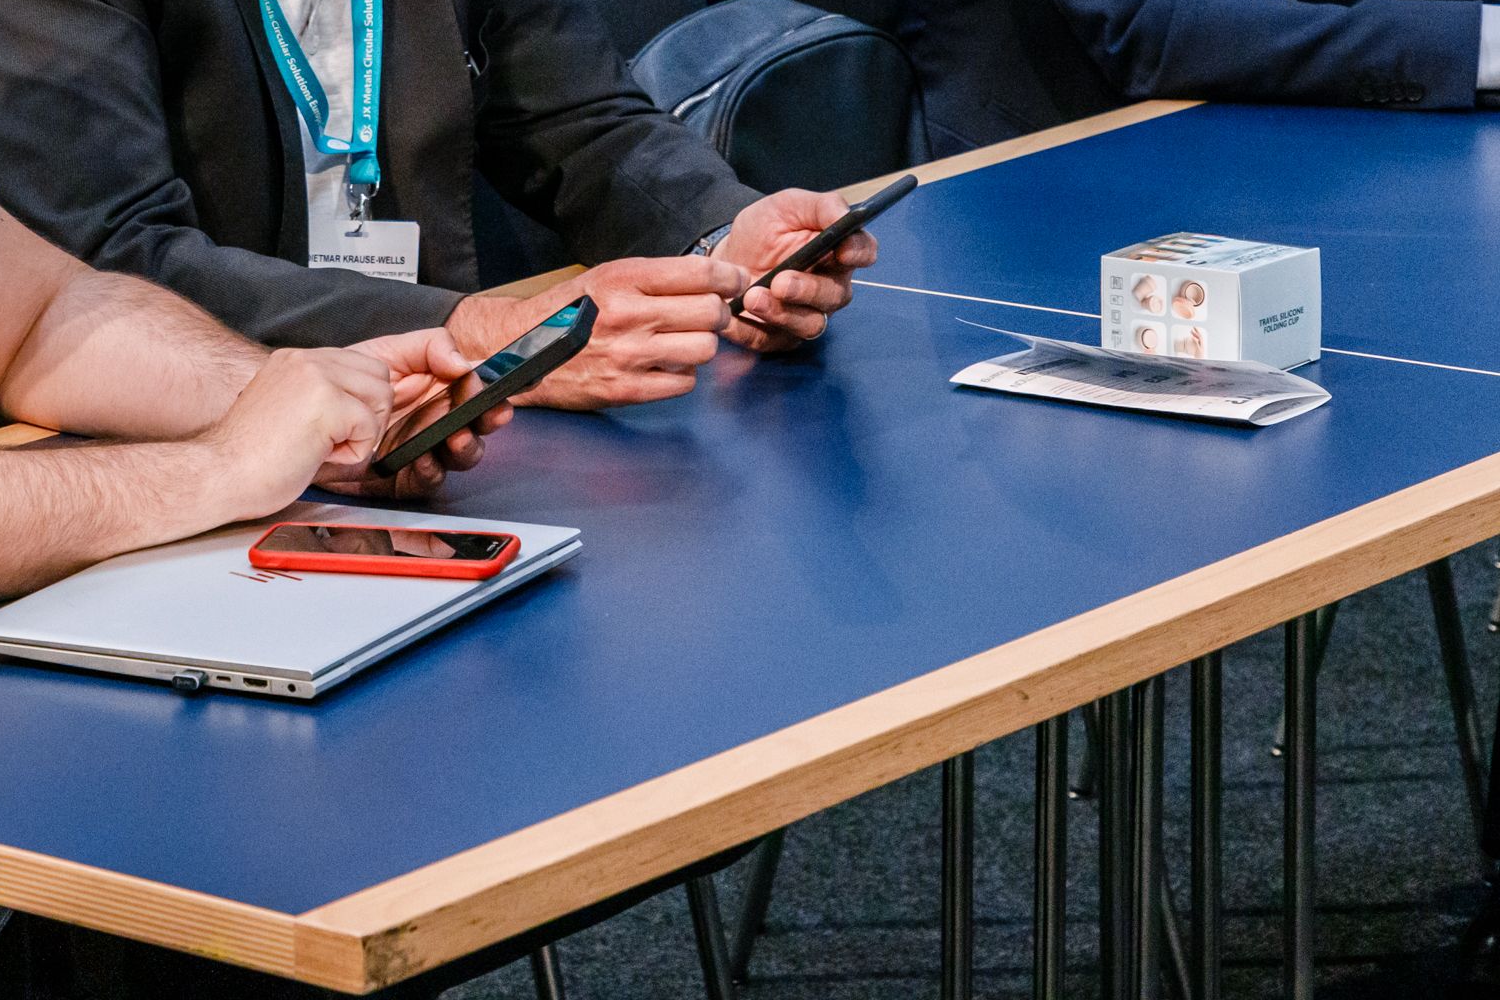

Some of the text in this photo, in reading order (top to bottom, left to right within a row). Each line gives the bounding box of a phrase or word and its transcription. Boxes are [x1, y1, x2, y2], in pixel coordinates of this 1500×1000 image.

[363, 28, 374, 68] Circular
[271, 20, 291, 57] Circular
[286, 56, 313, 101] Solutions
[362, 69, 373, 104] Metals
[363, 106, 372, 120] JX
[342, 255, 406, 265] KRAUSE-WELLS
[1259, 306, 1304, 327] TRAVEL SILICONE
[1263, 316, 1300, 334] FOLDING CUP
